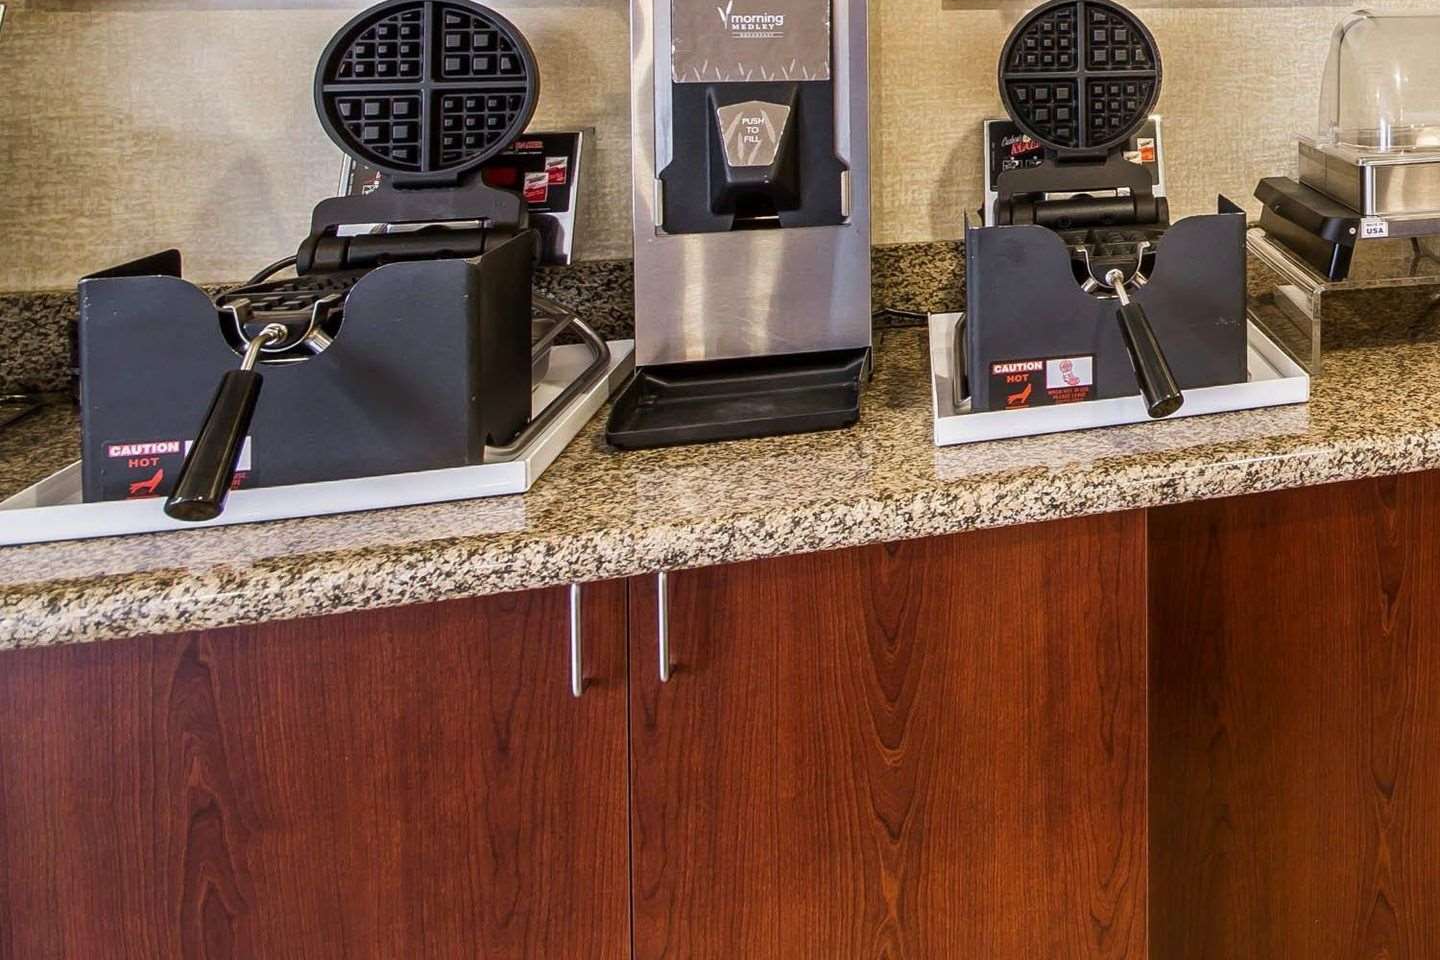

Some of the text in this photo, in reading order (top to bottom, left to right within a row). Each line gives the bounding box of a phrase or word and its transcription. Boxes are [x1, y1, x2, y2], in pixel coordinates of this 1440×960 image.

[731, 12, 784, 26] morning
[742, 117, 765, 125] PUSH
[746, 126, 760, 134] TO
[744, 135, 761, 143] FILL
[993, 361, 1043, 375] CAUTION
[1007, 373, 1029, 384] HOT
[109, 441, 180, 457] CAUTION
[128, 457, 160, 468] HOT
